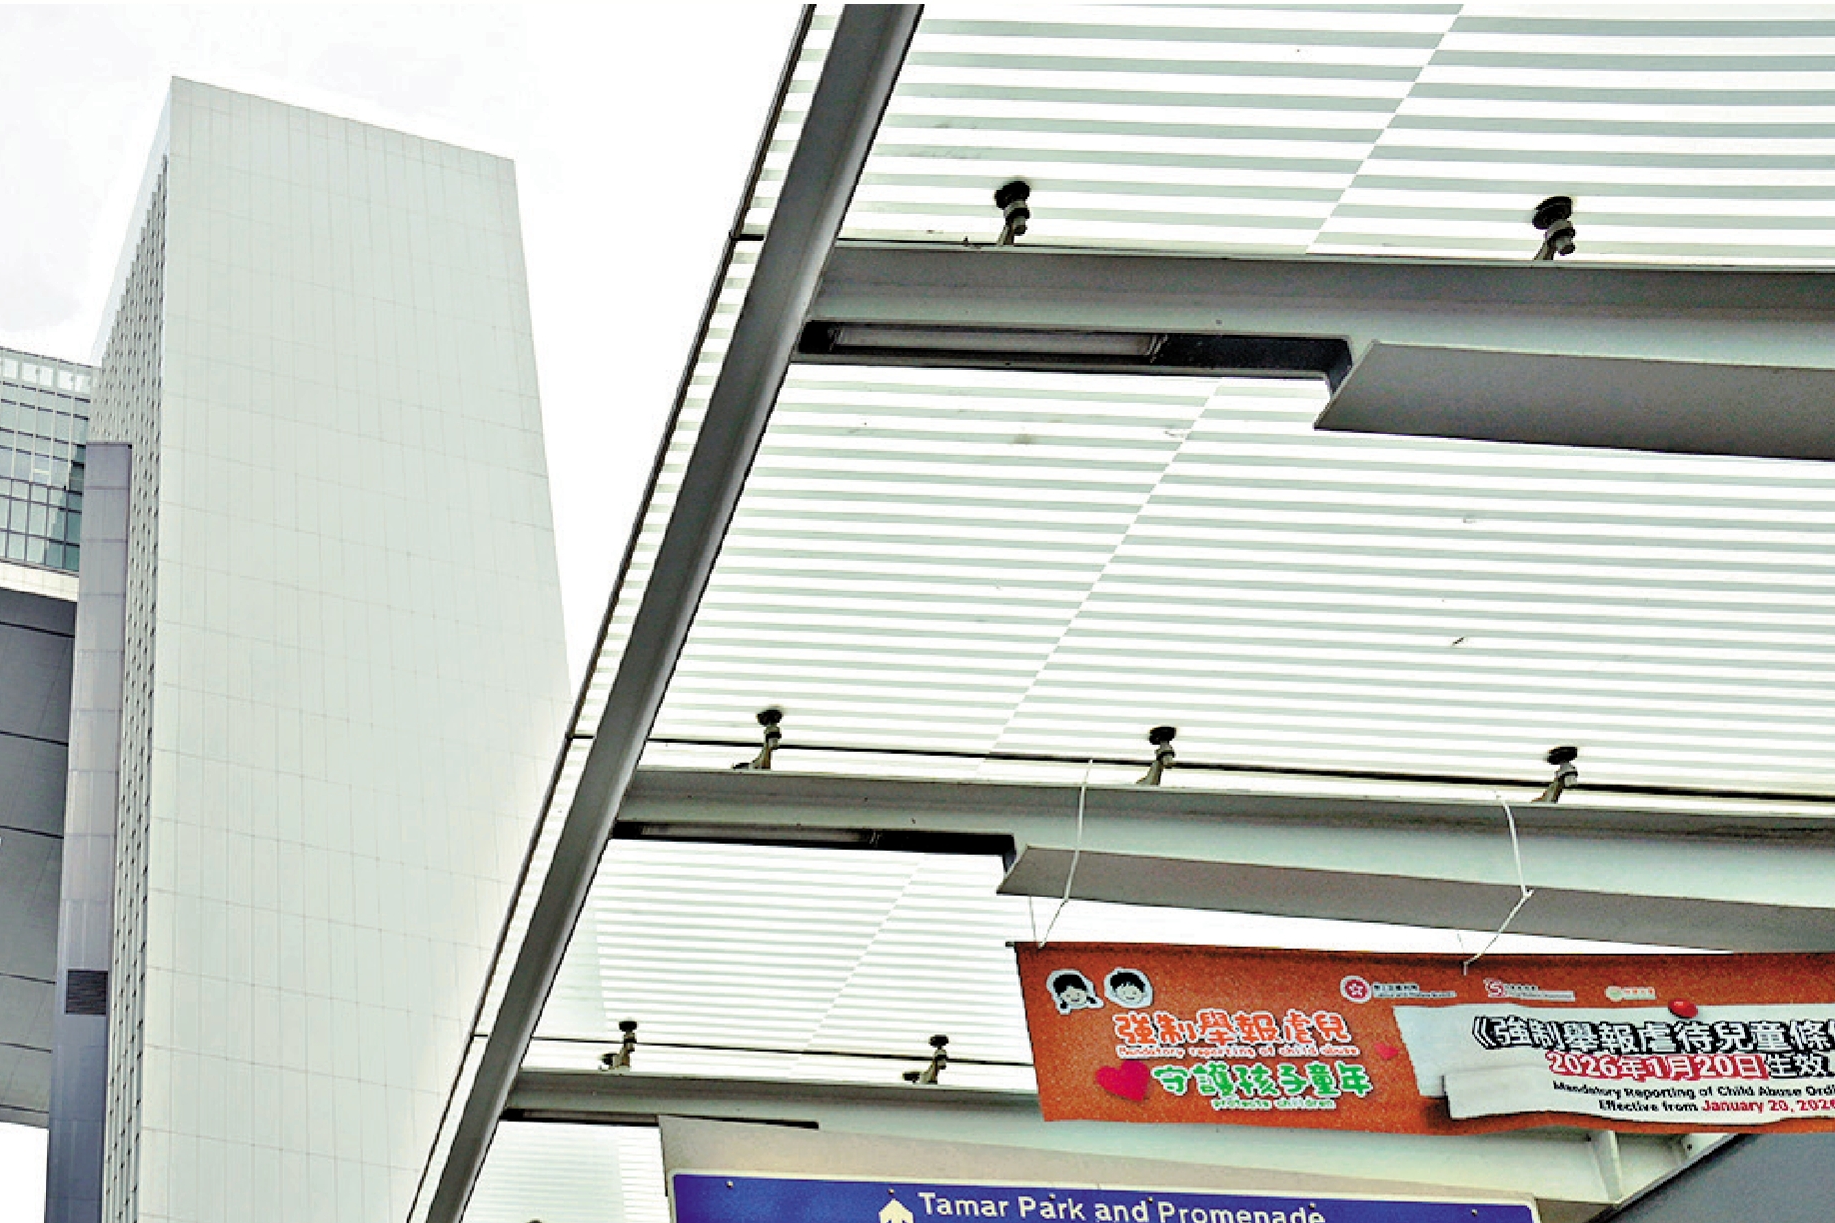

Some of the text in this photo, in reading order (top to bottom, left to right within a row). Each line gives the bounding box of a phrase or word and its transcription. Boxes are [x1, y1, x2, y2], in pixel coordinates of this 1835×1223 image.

[1114, 1008, 1351, 1046] 強制舉報虐兒
[1472, 1015, 1835, 1054] 《強制舉報虐待兒童條
[1151, 1060, 1373, 1097] 守護孩子童年
[1545, 1050, 1827, 1082] 2026年1月20日生效
[1553, 1080, 1621, 1100] Mandatory
[1624, 1086, 1696, 1100] Reporting
[1699, 1086, 1712, 1097] of
[1717, 1086, 1755, 1097] Child
[1758, 1086, 1802, 1097] Abuse
[1599, 1099, 1659, 1112] Effective
[1661, 1101, 1699, 1112] from
[1701, 1100, 1765, 1114] January
[917, 1191, 1010, 1217] Tamar
[1017, 1195, 1087, 1222] Park
[1094, 1200, 1150, 1223] and
